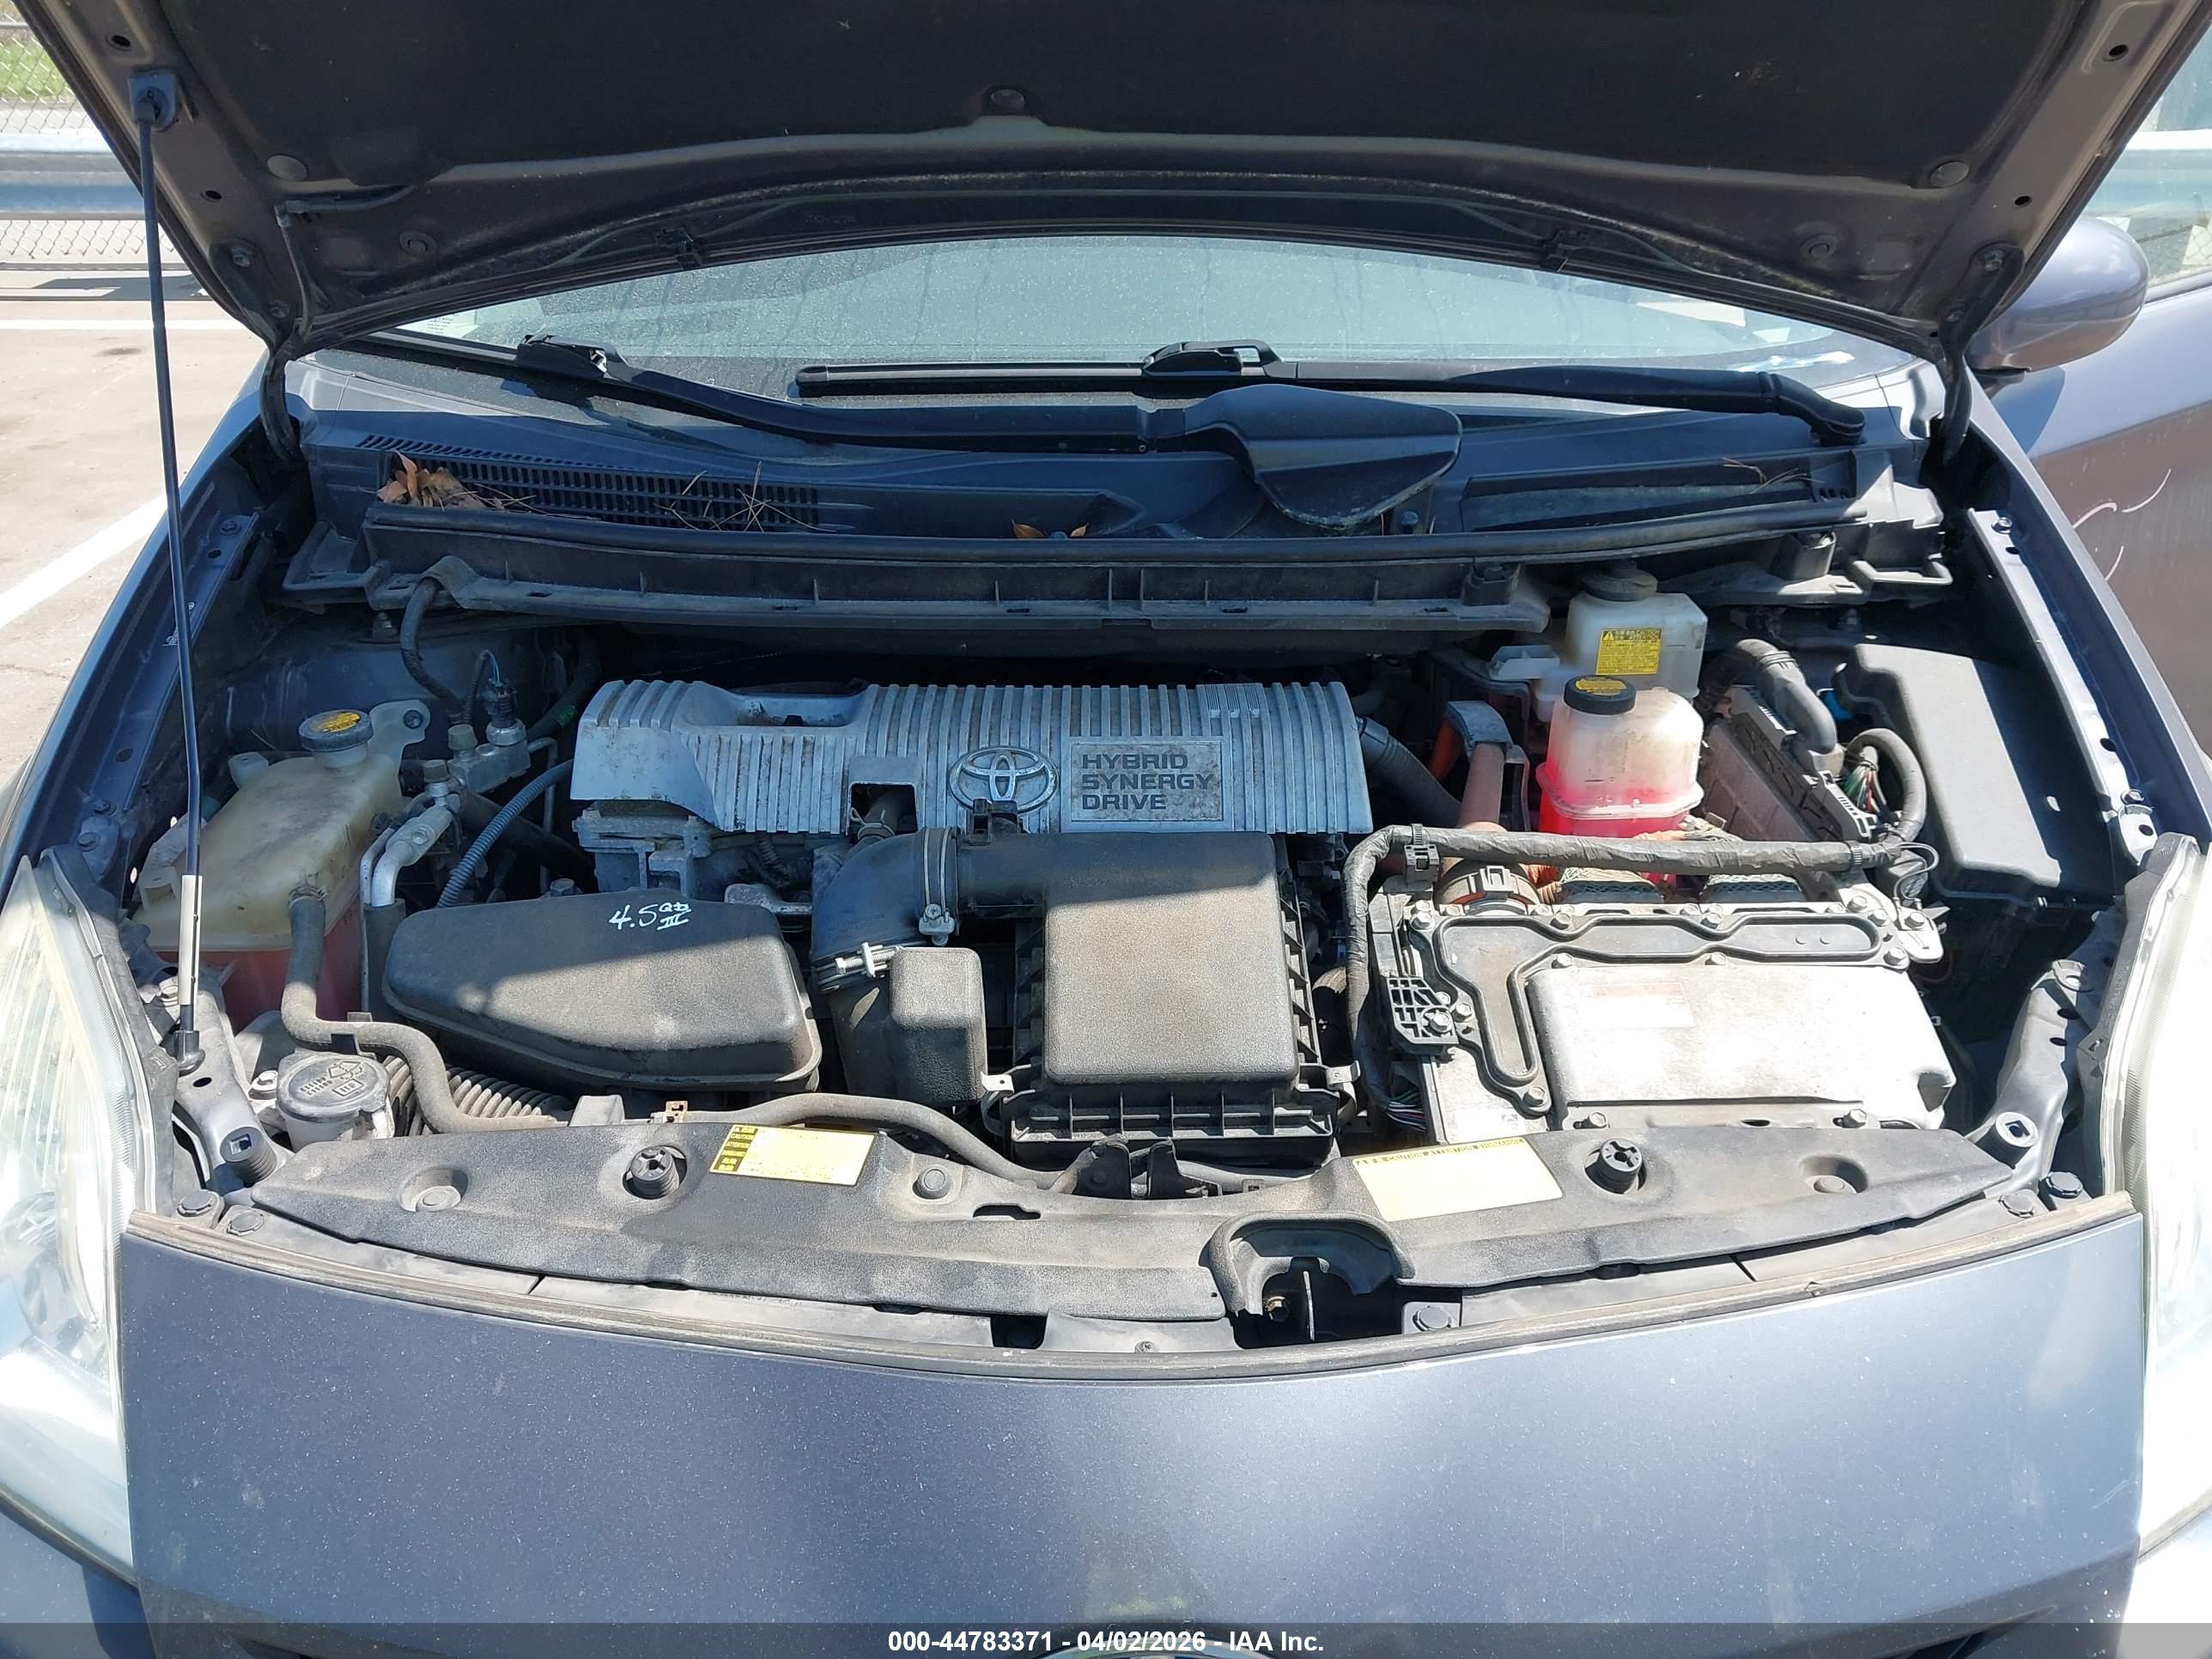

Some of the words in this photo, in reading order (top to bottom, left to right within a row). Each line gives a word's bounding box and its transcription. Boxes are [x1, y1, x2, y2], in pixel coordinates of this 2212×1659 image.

[1082, 754, 1188, 769] HYBRID
[1082, 774, 1214, 790] SYNERGY
[1082, 794, 1167, 810] DRIVE
[609, 904, 659, 930] 4.5
